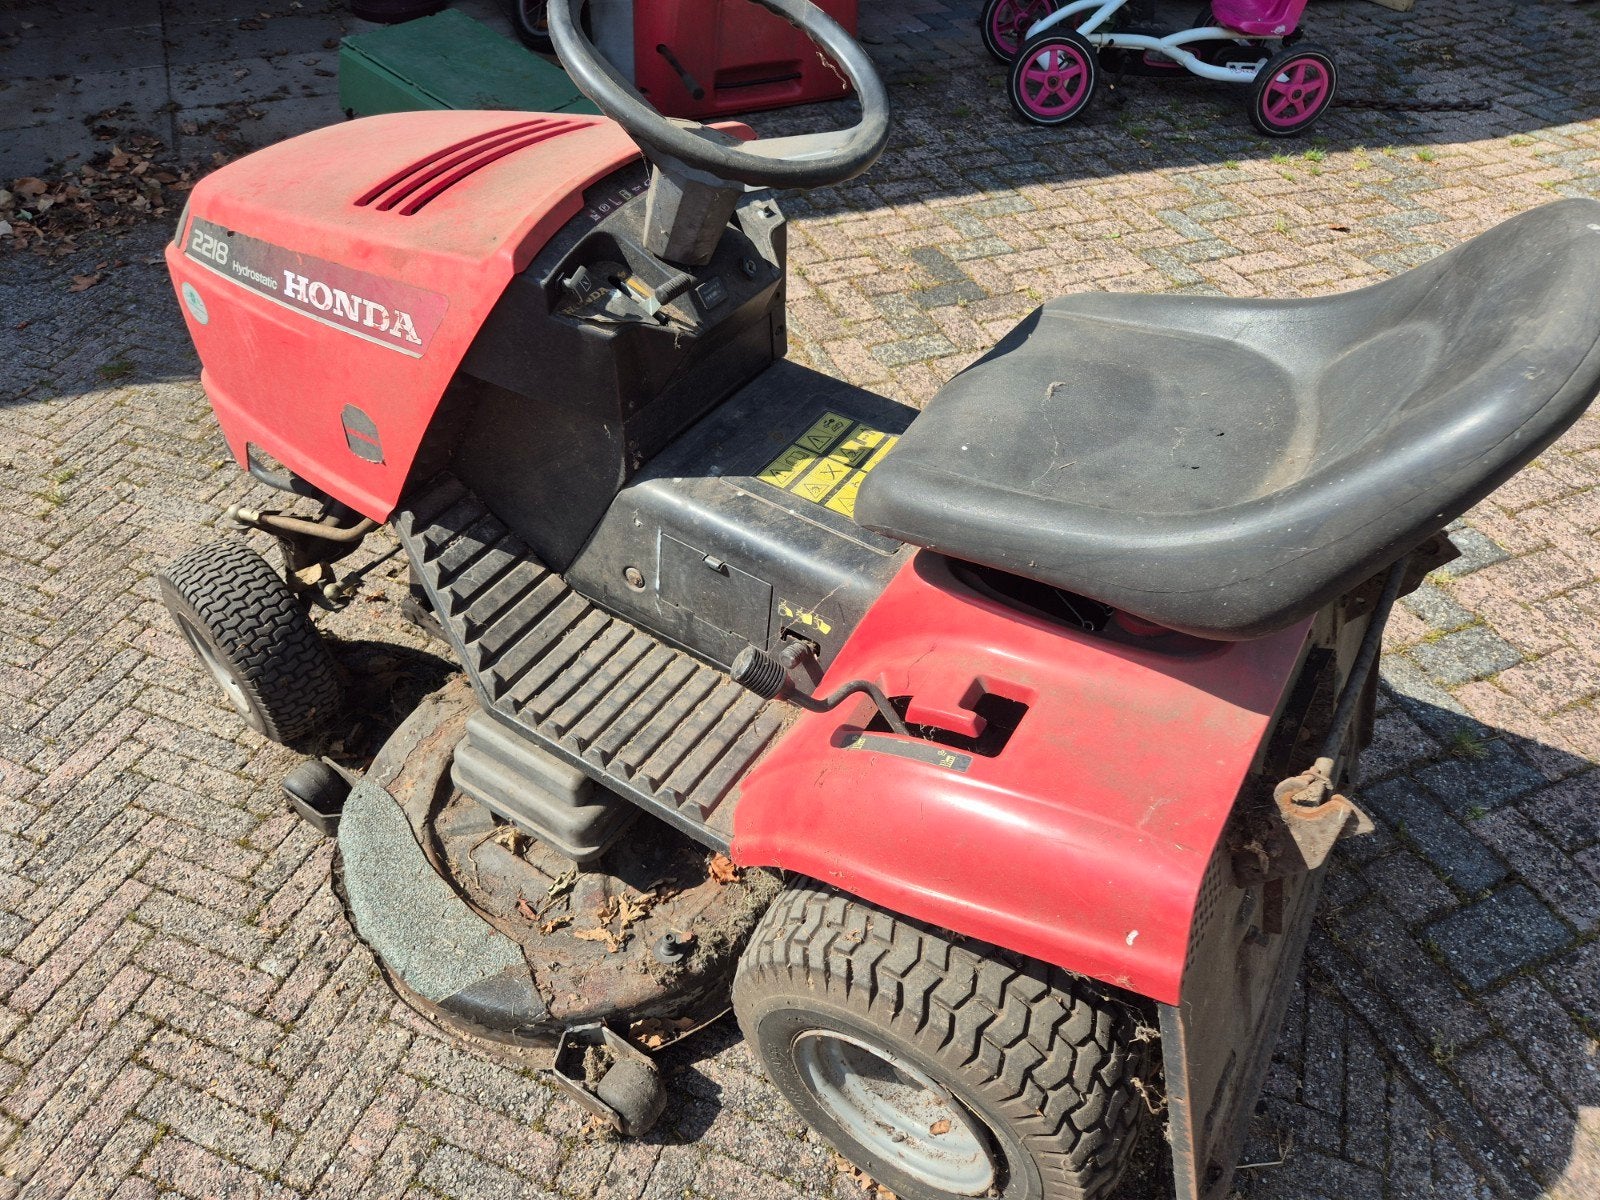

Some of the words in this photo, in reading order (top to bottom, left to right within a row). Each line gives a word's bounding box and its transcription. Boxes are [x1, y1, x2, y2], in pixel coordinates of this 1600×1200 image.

[192, 229, 229, 265] 2218
[232, 260, 278, 290] Hydrostatic
[283, 269, 422, 345] HONDA
